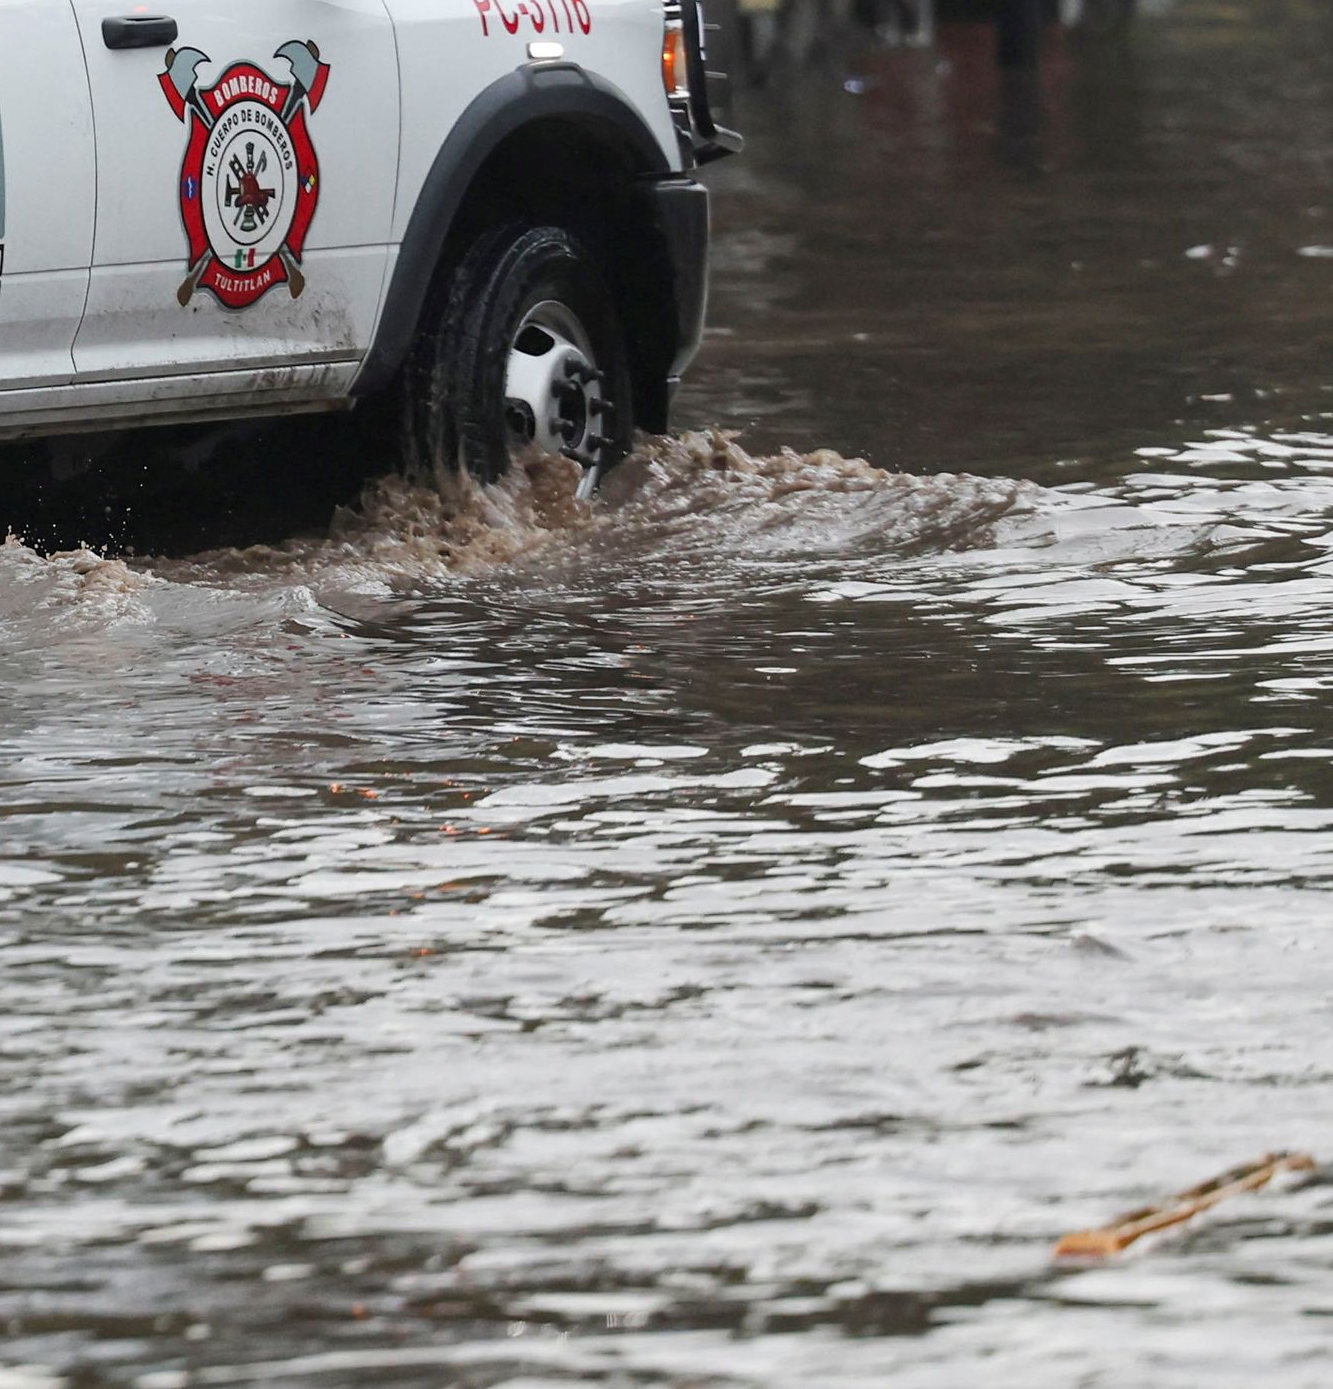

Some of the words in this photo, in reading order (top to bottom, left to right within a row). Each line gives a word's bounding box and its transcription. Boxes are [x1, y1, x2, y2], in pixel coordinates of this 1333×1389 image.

[213, 75, 278, 107] BOMBEROS
[210, 113, 238, 158] CUERPO
[240, 109, 253, 123] DE
[254, 110, 293, 171] BOMBEROS
[214, 270, 271, 292] TULTITLAN
